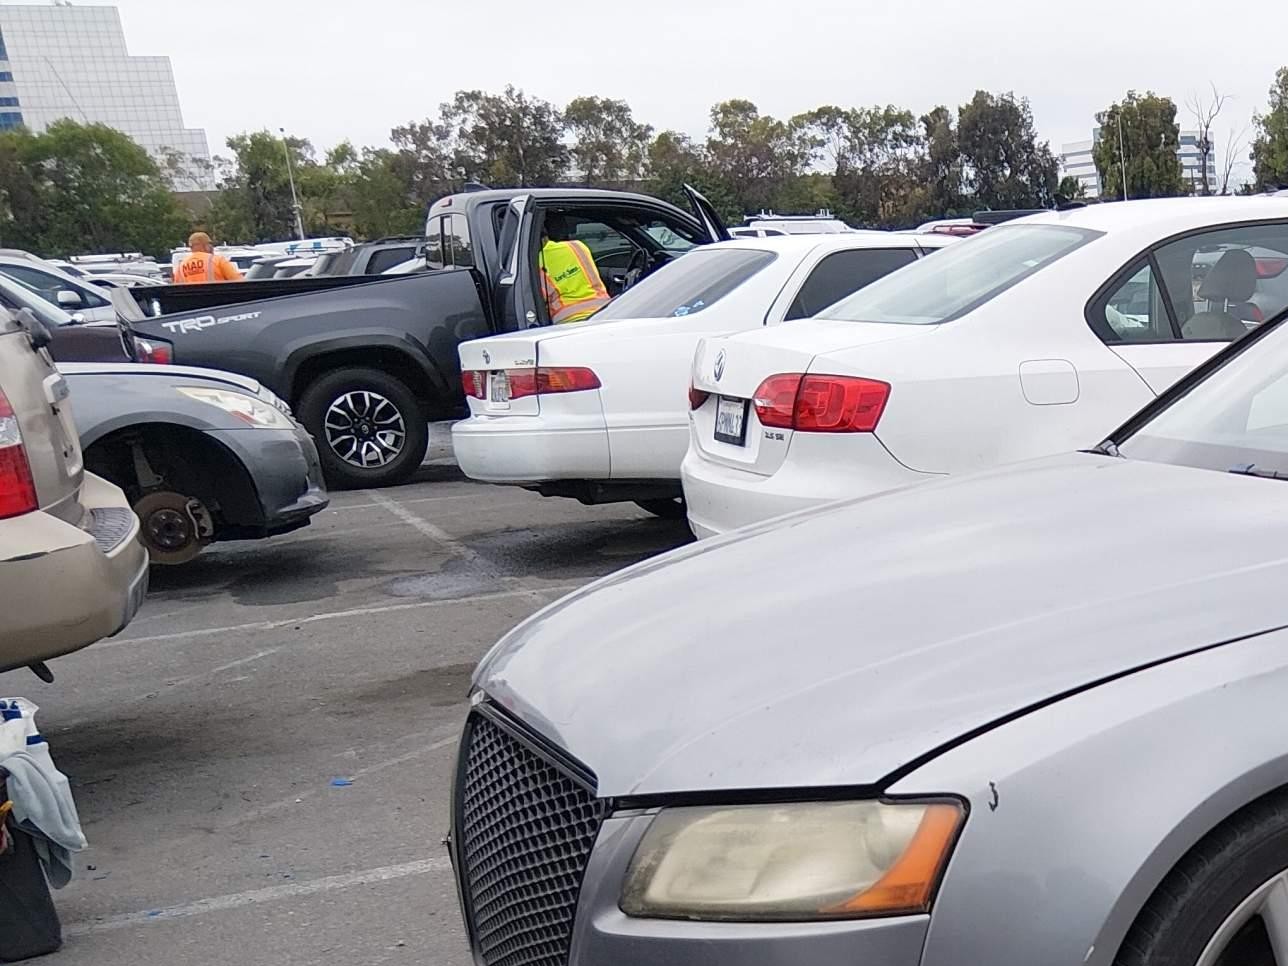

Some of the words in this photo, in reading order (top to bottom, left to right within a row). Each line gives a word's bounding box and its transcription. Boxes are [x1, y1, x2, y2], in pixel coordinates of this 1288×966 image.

[182, 259, 205, 273] MAD
[161, 315, 216, 334] TRD
[217, 311, 262, 325] SPORT
